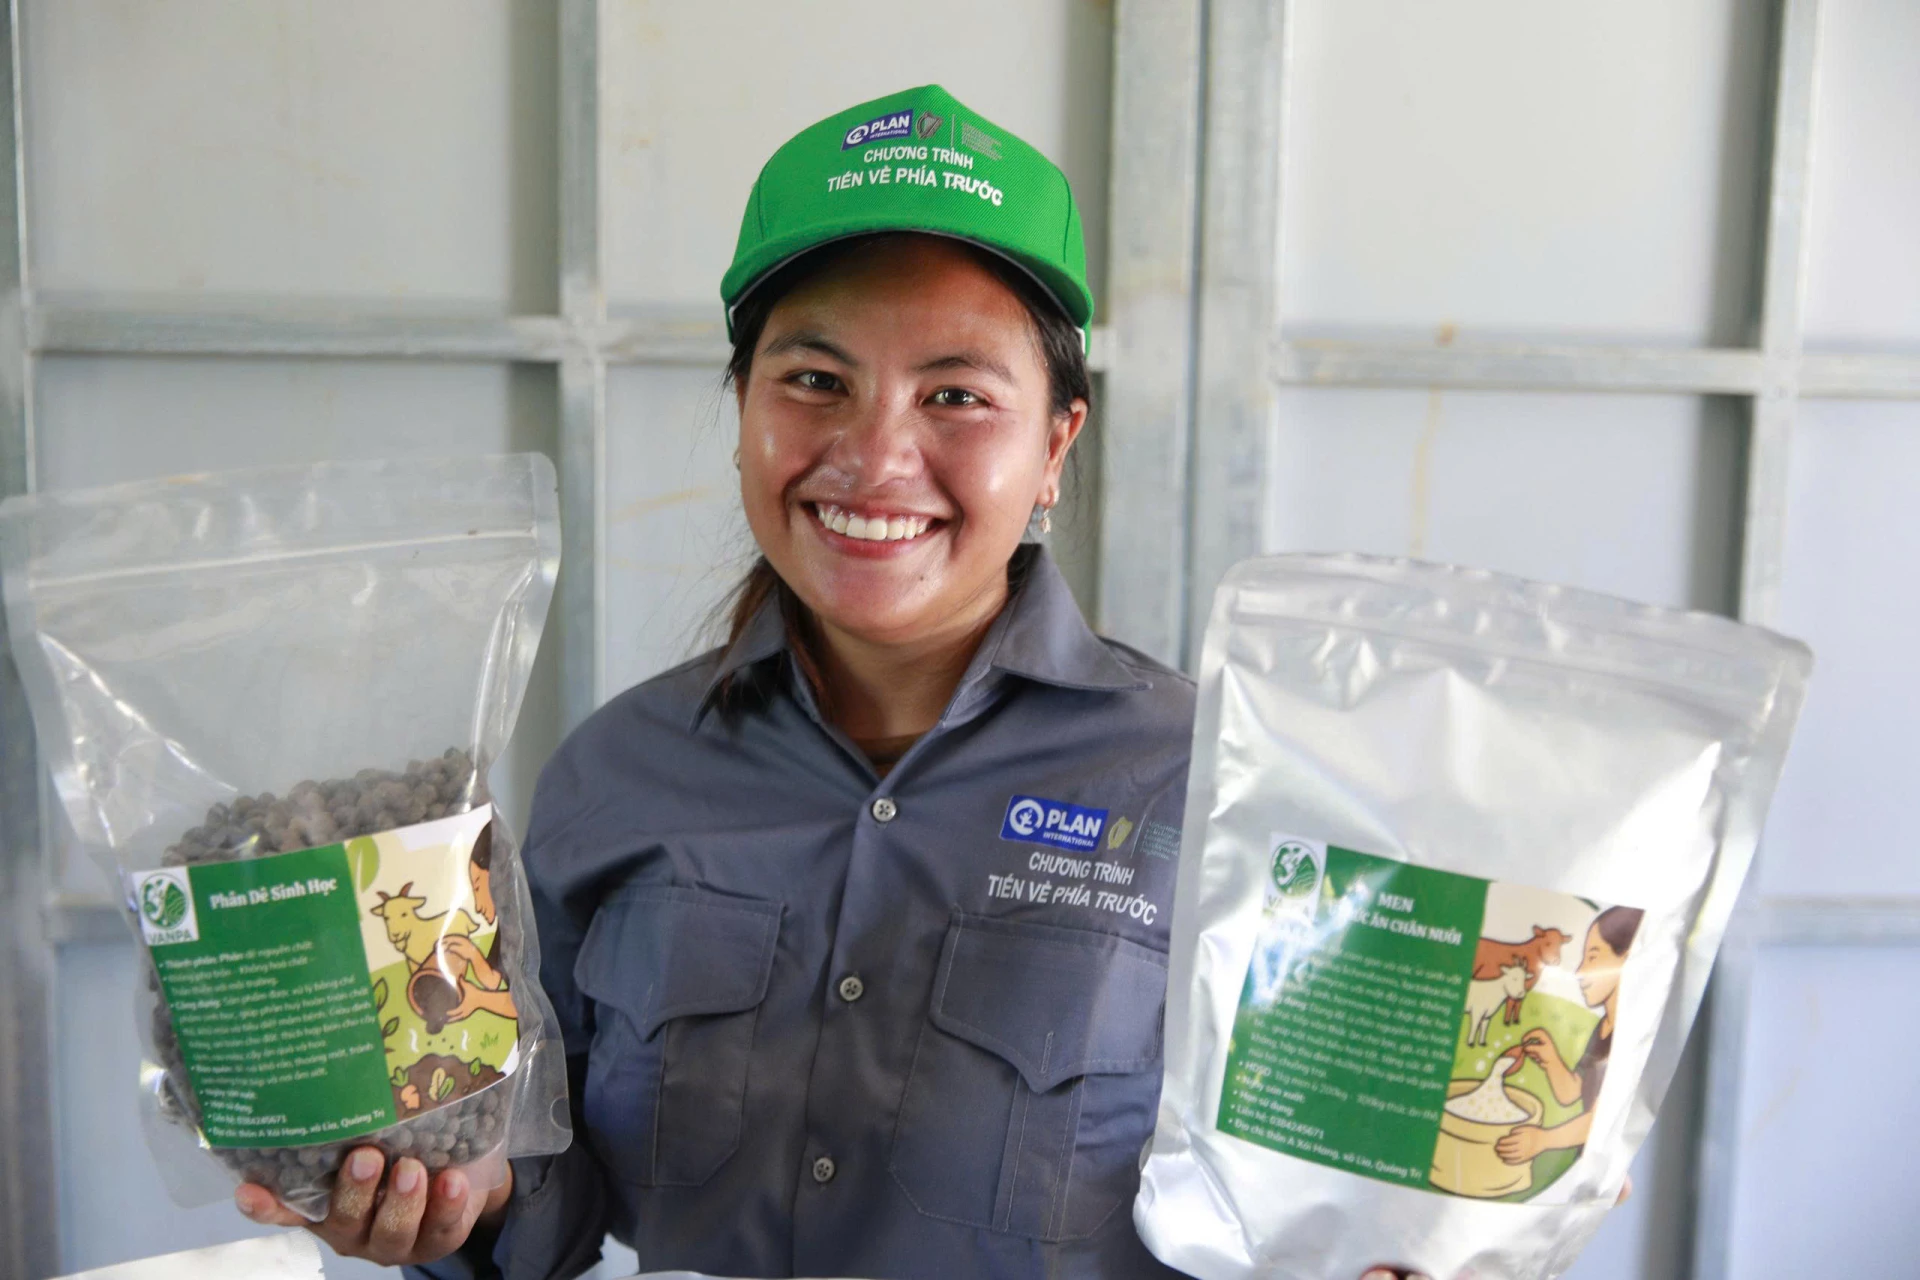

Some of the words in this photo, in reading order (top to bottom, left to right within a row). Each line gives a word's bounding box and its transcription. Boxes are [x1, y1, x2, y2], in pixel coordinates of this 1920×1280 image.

[869, 130, 908, 139] INTERNATIONAL
[870, 115, 910, 133] PLAN
[864, 146, 928, 163] CHƯƠNG
[933, 148, 974, 170] TRÌNH
[896, 165, 937, 187] PHÍA
[943, 172, 1004, 206] TRƯỚC
[1046, 809, 1102, 837] PLAN
[1043, 832, 1094, 847] INTERNATIONAL
[1029, 852, 1091, 878] CHƯƠNG
[1094, 861, 1135, 885] TRÌNH
[210, 893, 248, 910] Phân
[251, 887, 269, 904] Dê
[271, 882, 306, 900] Sinh
[307, 878, 337, 896] Học
[1052, 884, 1091, 907] PHÍA
[1096, 891, 1157, 925] TRƯỚC
[1377, 892, 1415, 913] MEN
[150, 929, 192, 943] VANPA
